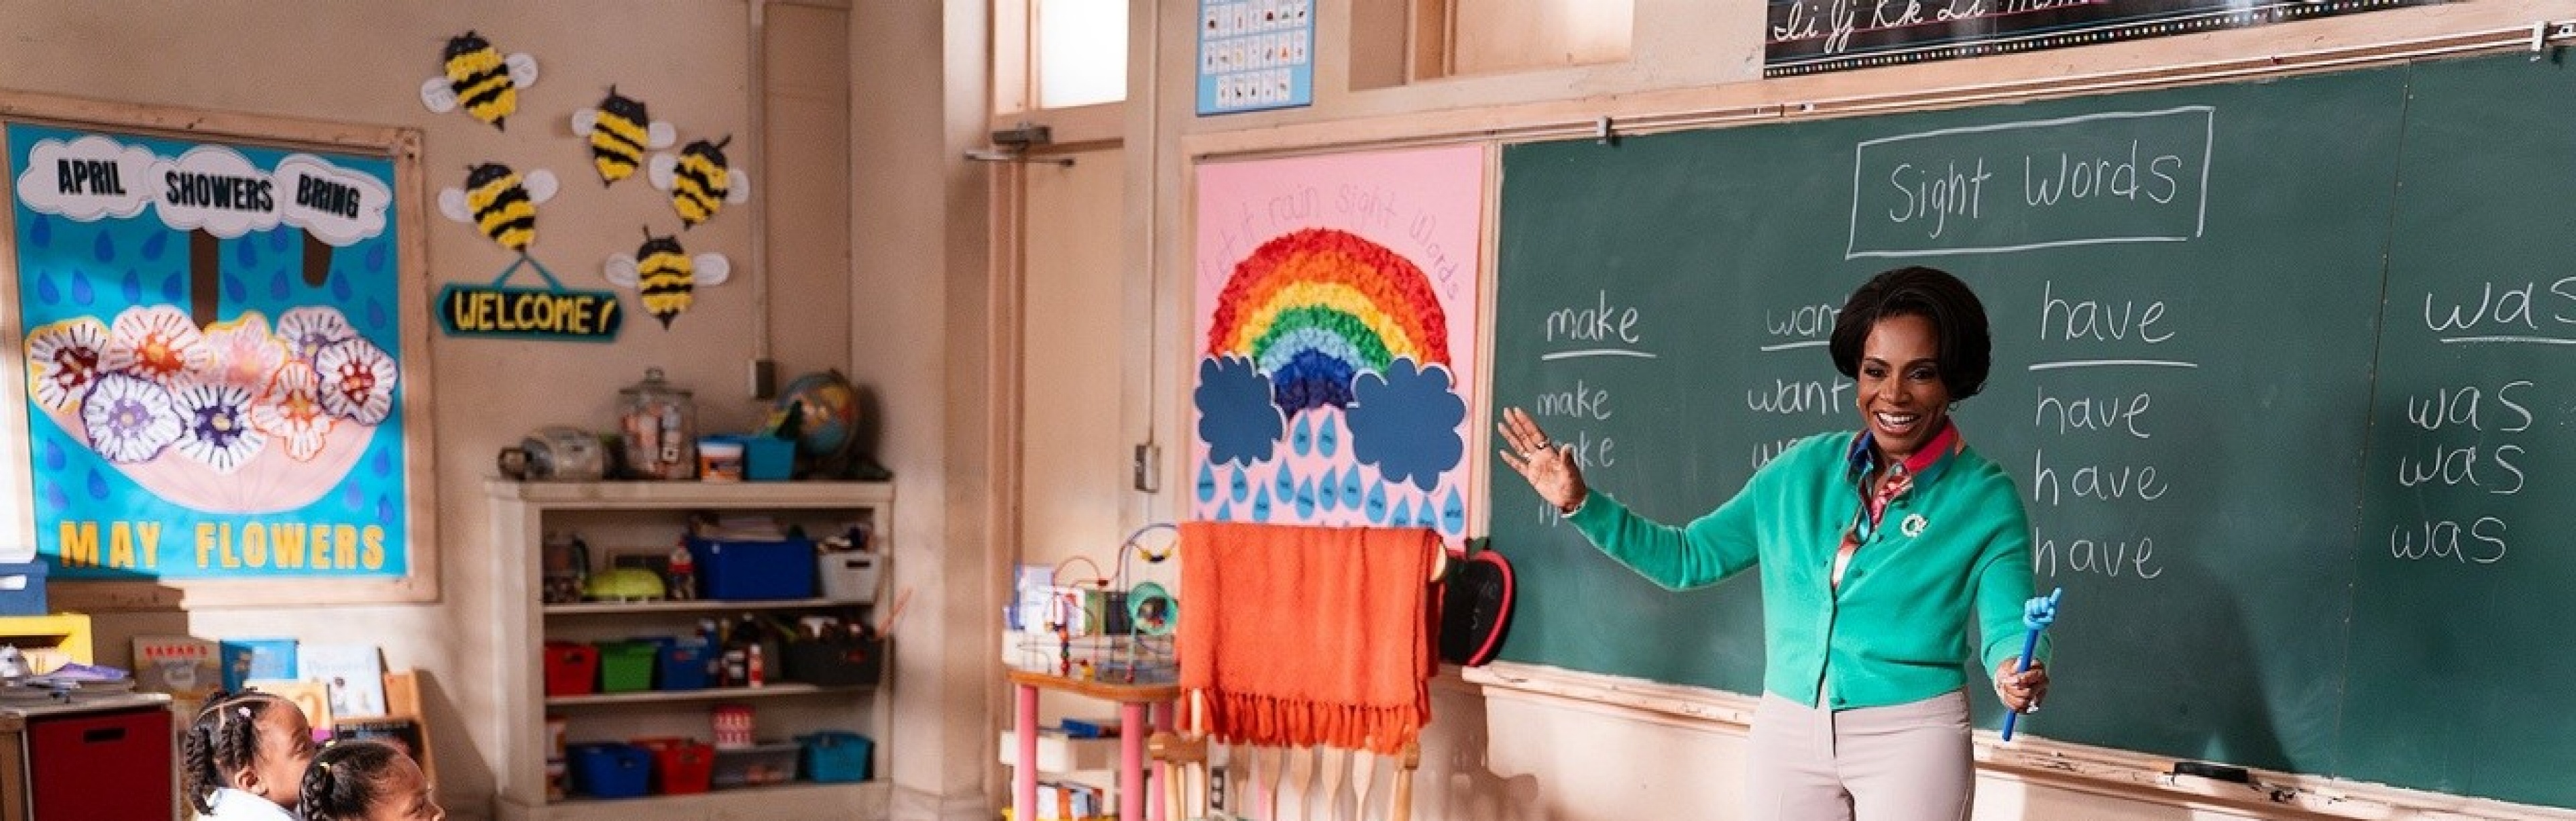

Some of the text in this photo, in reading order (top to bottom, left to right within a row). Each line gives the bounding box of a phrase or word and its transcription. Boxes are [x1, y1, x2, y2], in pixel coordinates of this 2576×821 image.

[57, 158, 361, 220] APRIL SHOWERS BRING
[1889, 139, 2182, 238] Sight Words
[454, 290, 617, 334] WELCOME!
[1546, 289, 1639, 343] make
[2041, 280, 2176, 343] have
[2426, 276, 2576, 331] was
[1537, 379, 1612, 421] make
[1748, 376, 1853, 416] want
[2035, 386, 2151, 438] have
[2408, 380, 2534, 432] was
[2035, 448, 2168, 506] have
[2399, 443, 2526, 494] was
[59, 521, 386, 570] MAY FLOWERS
[2035, 526, 2163, 579] have
[2391, 516, 2507, 563] was
